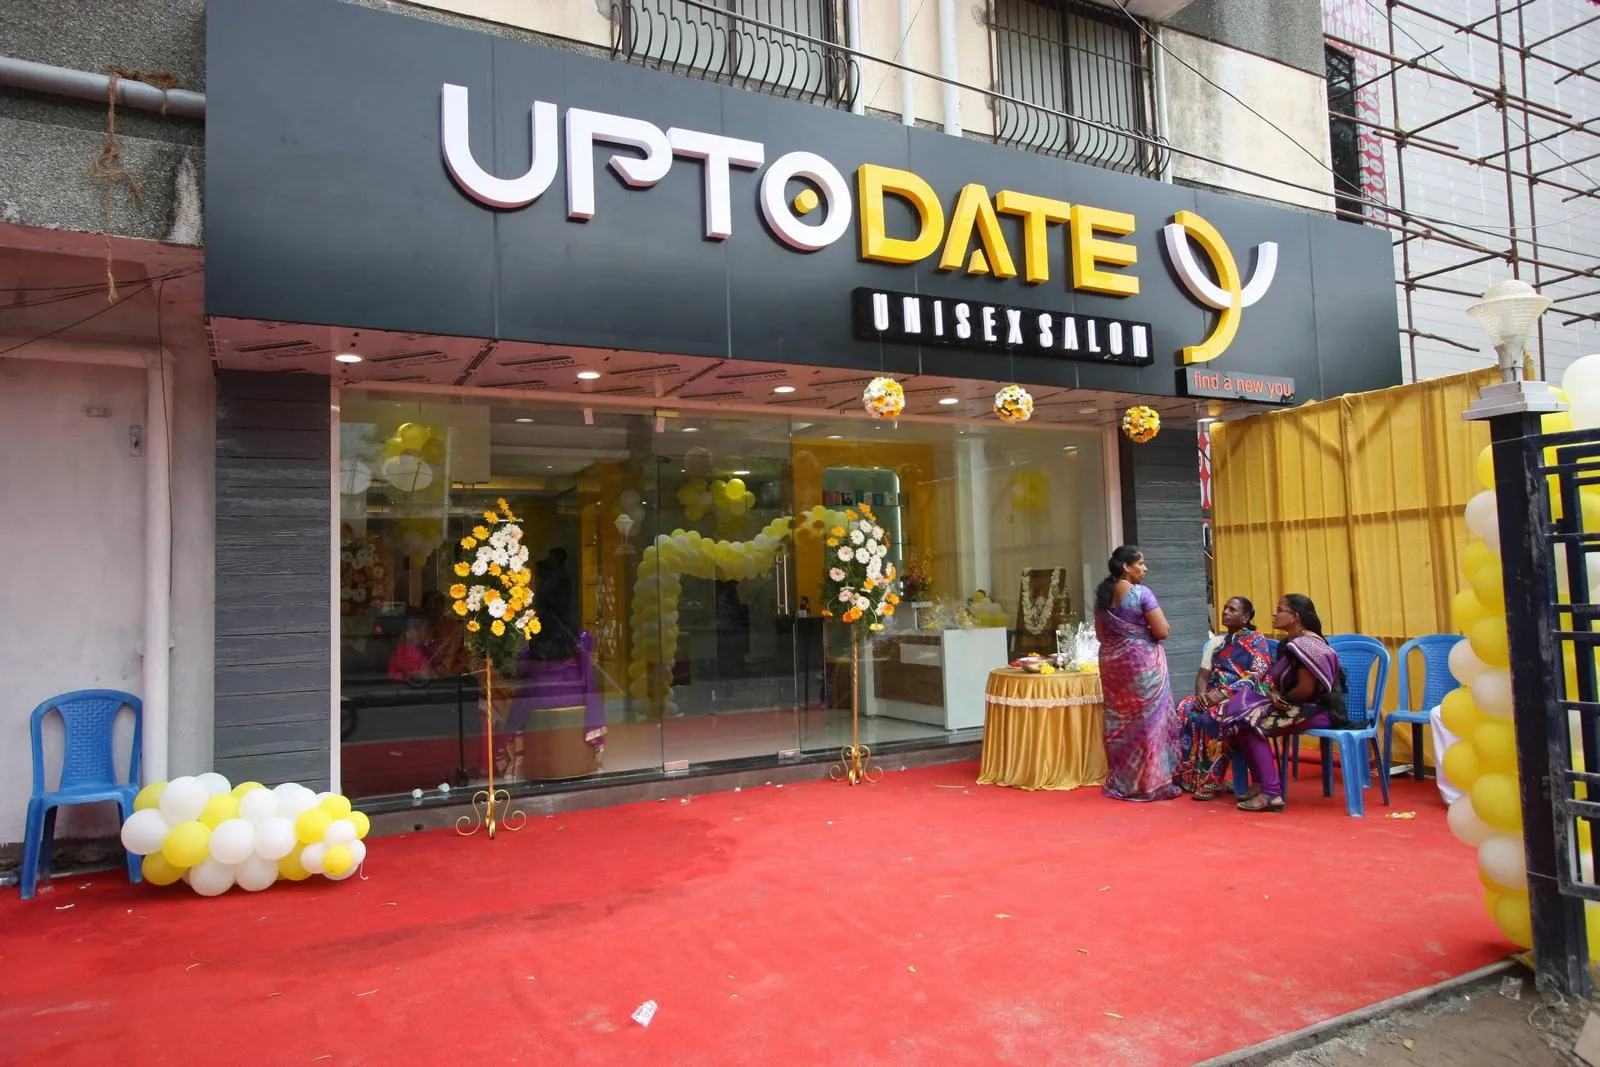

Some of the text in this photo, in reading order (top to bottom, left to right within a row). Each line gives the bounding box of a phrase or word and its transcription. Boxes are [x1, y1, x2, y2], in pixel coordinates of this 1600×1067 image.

[872, 293, 1149, 358] UNISEX SALON
[1192, 370, 1291, 399] find a new you
